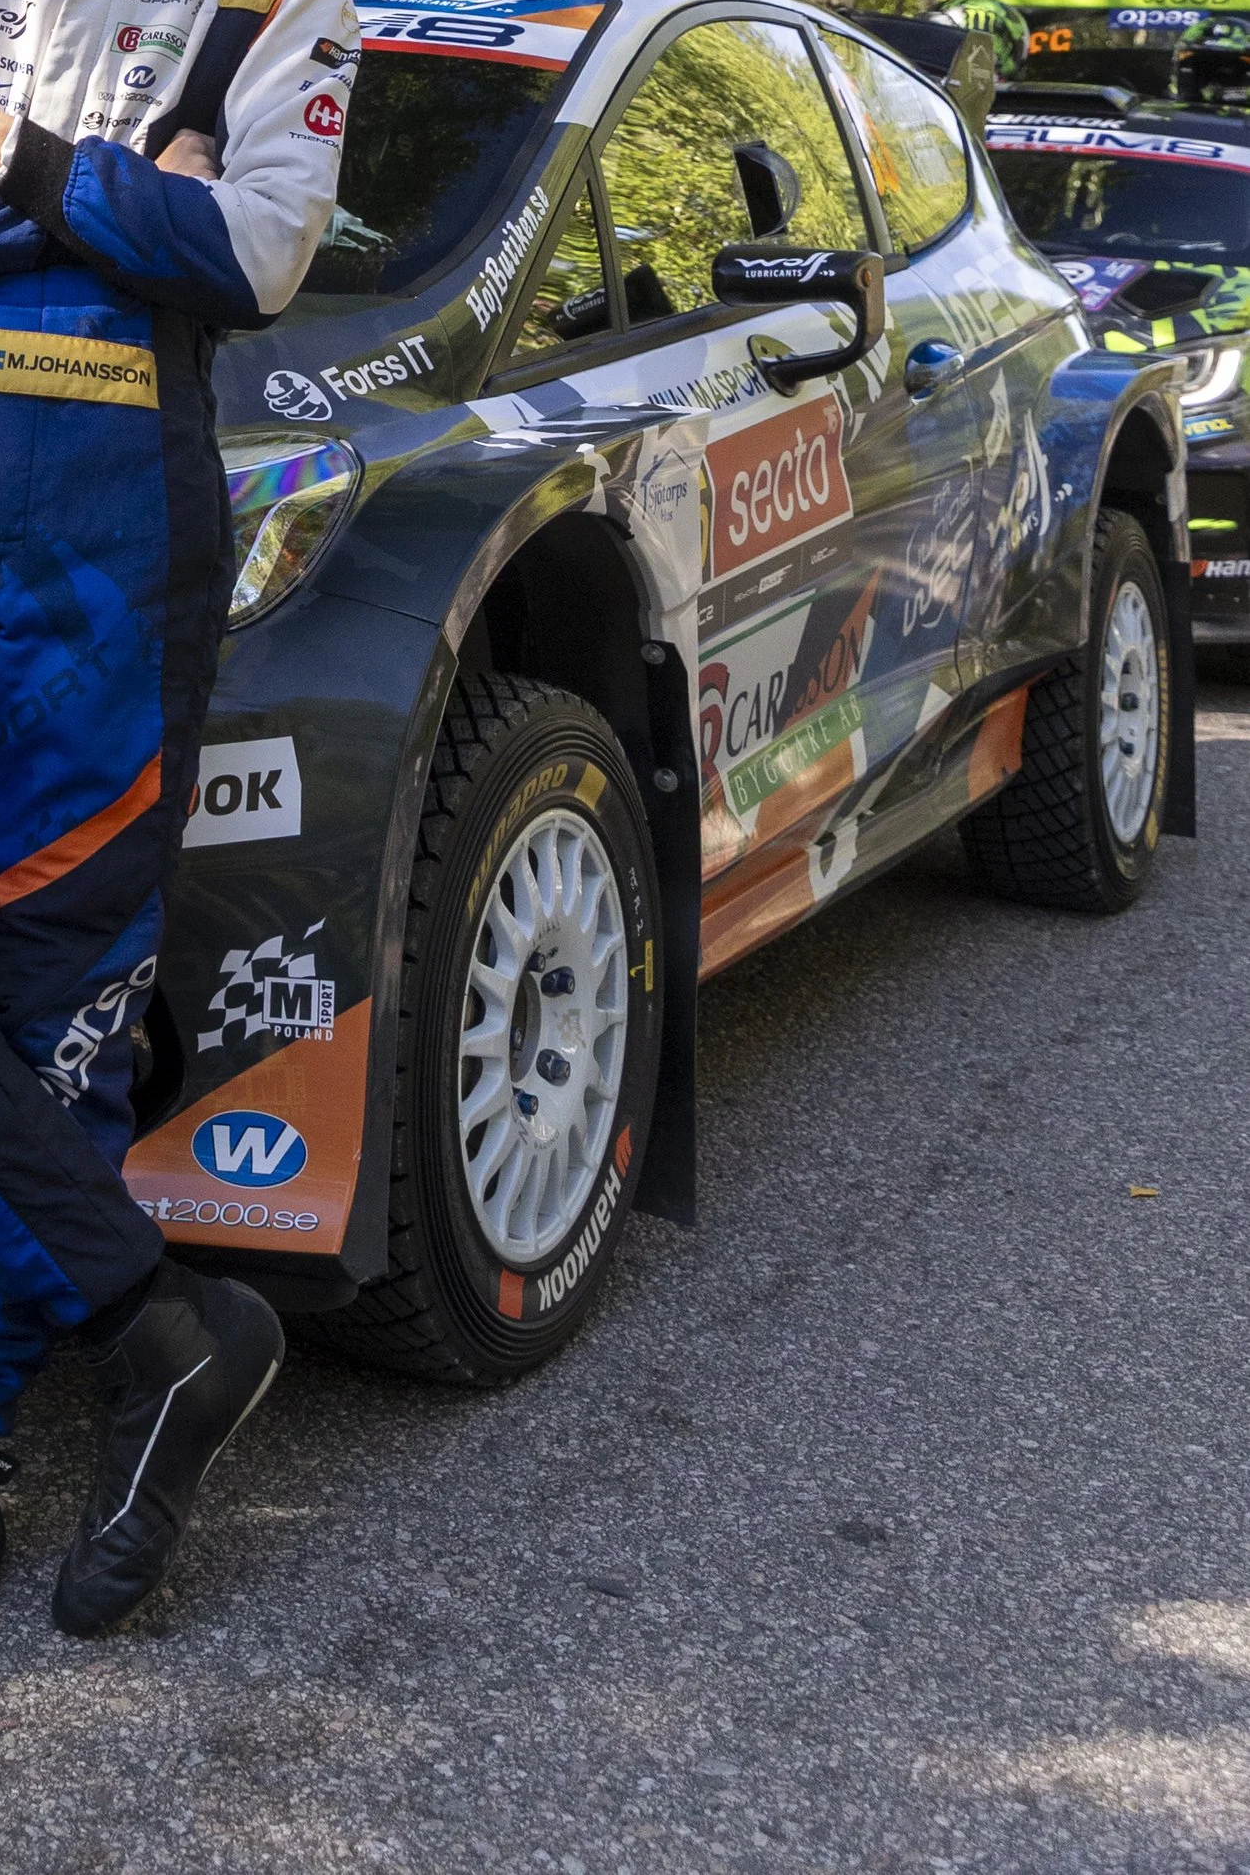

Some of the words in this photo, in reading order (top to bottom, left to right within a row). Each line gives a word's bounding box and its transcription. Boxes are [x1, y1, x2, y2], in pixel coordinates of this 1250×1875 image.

[1116, 9, 1200, 25] secto
[745, 269, 803, 278] LUBRICANTS
[7, 352, 151, 388] M.JOHANSSON
[320, 353, 409, 402] Forss
[398, 335, 435, 375] IT
[649, 481, 688, 513] Sjötorps
[728, 427, 830, 547] secto
[734, 715, 832, 806] BYGGARE
[838, 693, 862, 730] AB
[321, 983, 333, 1025] SPORT
[274, 1025, 334, 1041] POLAND
[212, 1124, 300, 1175] W
